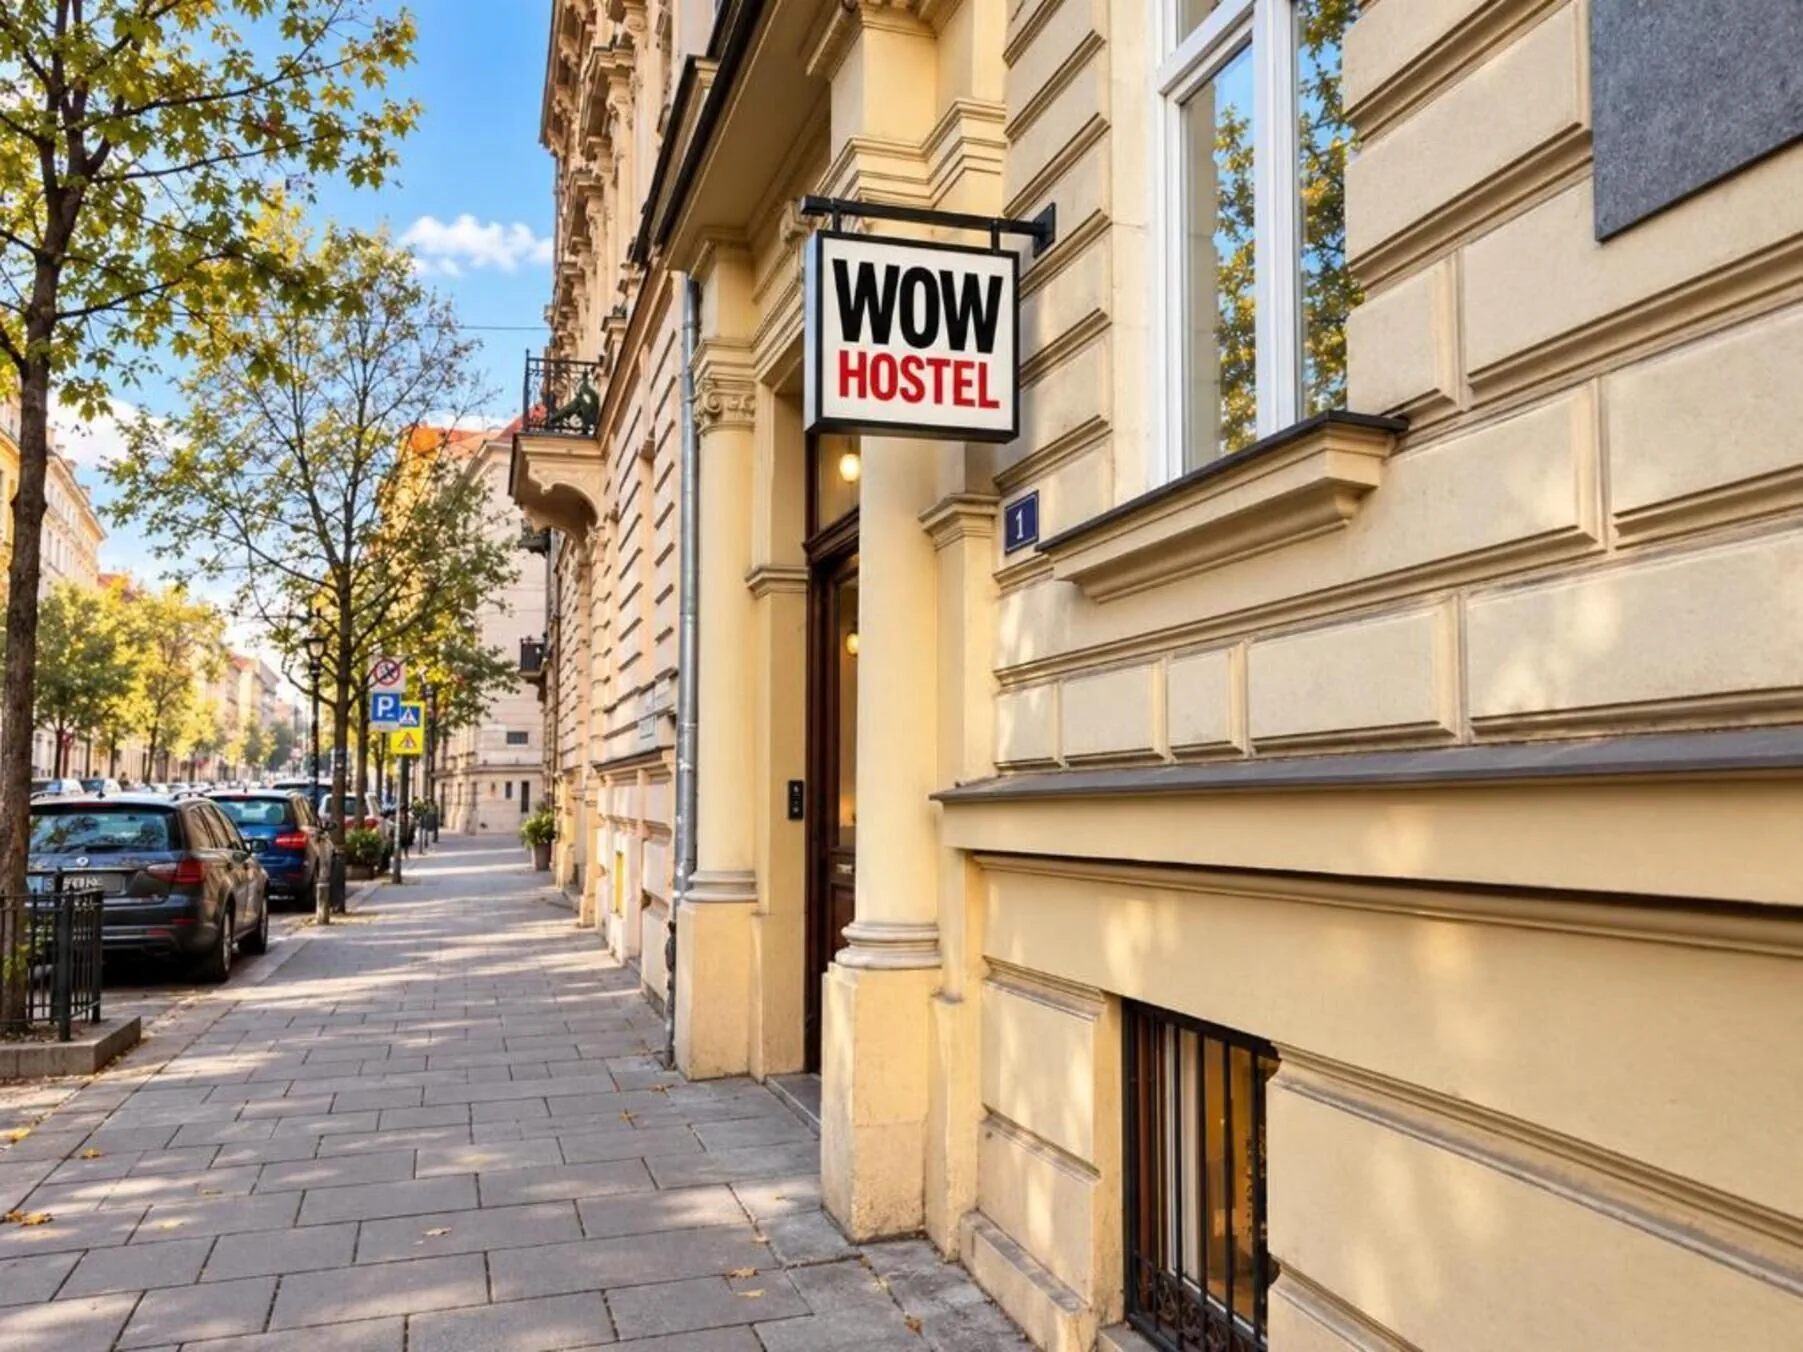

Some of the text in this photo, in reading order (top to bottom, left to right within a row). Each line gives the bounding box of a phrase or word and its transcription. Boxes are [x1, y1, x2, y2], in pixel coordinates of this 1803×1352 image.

[832, 258, 1003, 354] WOW
[838, 350, 1000, 409] HOSTEL
[1015, 509, 1024, 539] 1
[377, 696, 395, 717] P
